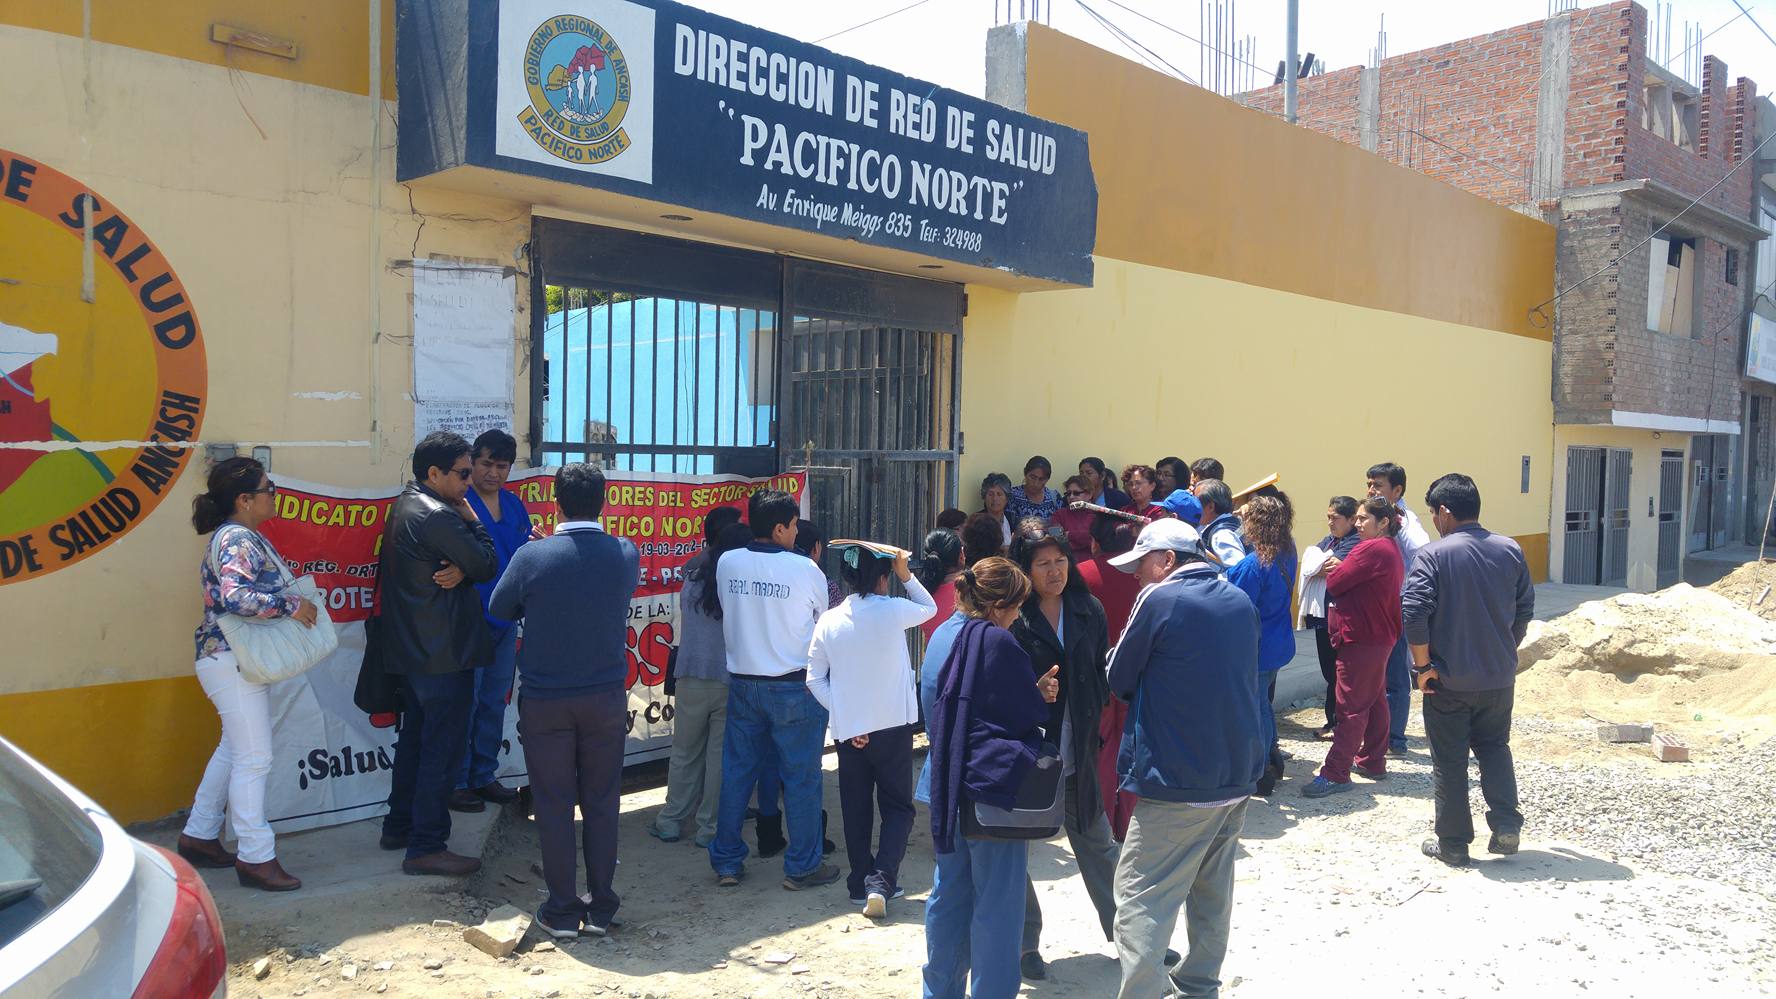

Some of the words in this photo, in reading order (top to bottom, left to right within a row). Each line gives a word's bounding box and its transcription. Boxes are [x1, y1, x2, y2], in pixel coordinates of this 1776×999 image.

[527, 25, 553, 86] GOBIERNO
[555, 18, 604, 44] REGIONAL
[605, 39, 615, 56] DE
[674, 23, 834, 116] DIRECCION
[846, 74, 879, 128] DE
[889, 88, 937, 143] RED
[946, 105, 975, 154] DE
[985, 119, 1057, 175] SALUD
[524, 115, 583, 161] PACIFICO
[588, 134, 625, 161] NORTE
[543, 109, 565, 132] RED
[570, 125, 581, 139] DE
[585, 121, 609, 139] SALUD
[756, 183, 777, 211] Av.
[783, 189, 838, 229] Enrique
[839, 202, 883, 238] Meiggs
[885, 212, 912, 238] 835
[943, 226, 982, 253] 324988
[0, 158, 37, 202] E
[59, 192, 197, 350] SALUD
[0, 534, 44, 580] DE
[49, 487, 141, 561] SALUD
[131, 390, 200, 495] ANCASH
[659, 491, 684, 507] DEL
[691, 485, 747, 510] SECTOR
[302, 560, 341, 575] REG.
[728, 579, 749, 595] REAL
[752, 581, 791, 600] MADRID
[648, 602, 670, 618] LA:
